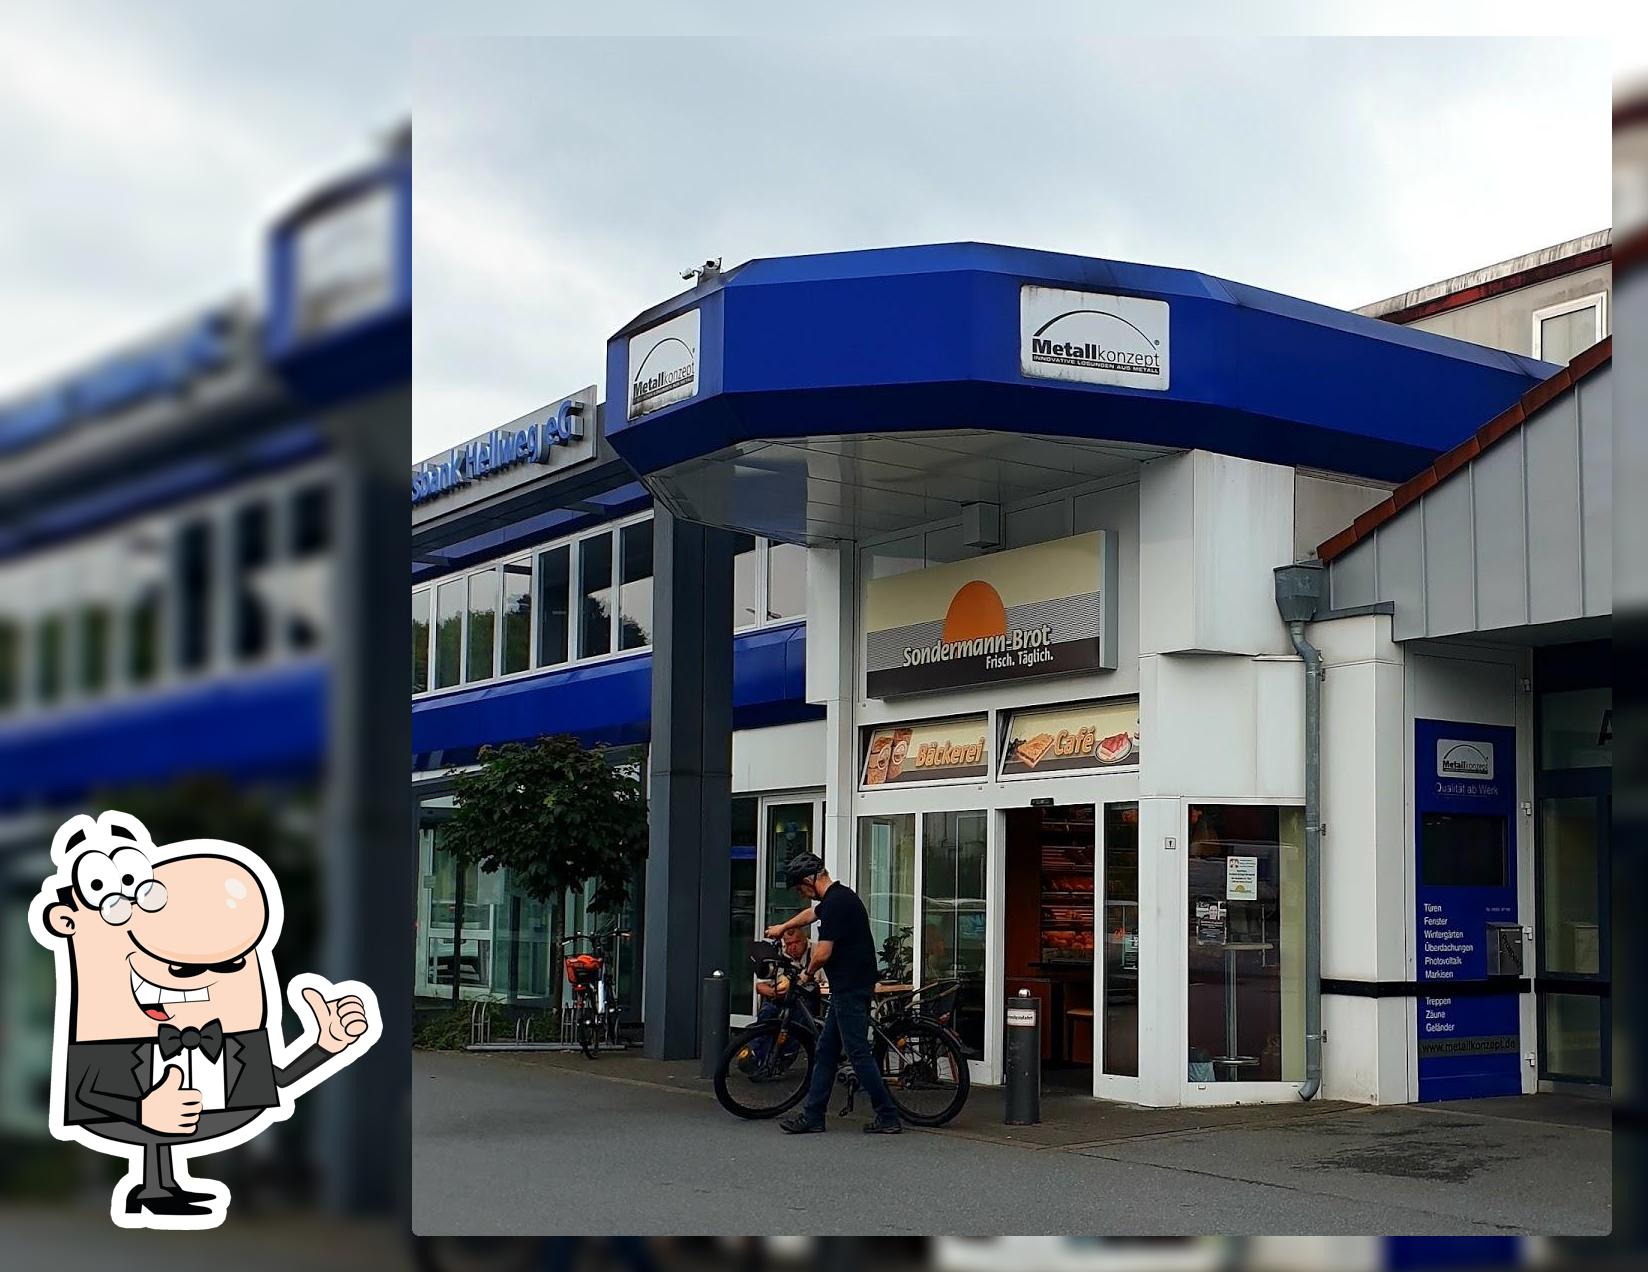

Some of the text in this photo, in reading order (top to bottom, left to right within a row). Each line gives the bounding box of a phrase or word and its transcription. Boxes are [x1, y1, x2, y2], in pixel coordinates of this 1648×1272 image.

[1032, 339, 1159, 367] Metallkonzept
[1033, 354, 1077, 365] INNOVATIVE
[1116, 364, 1131, 372] AUS
[1132, 366, 1159, 374] METALL
[633, 362, 695, 399] Metallkonzept
[465, 424, 546, 480] Hellweg
[545, 399, 584, 446] eG
[902, 624, 1051, 666] Sondermann-Brot
[985, 647, 1054, 670] Frisch. Täglich.
[1053, 725, 1096, 757] Café
[915, 737, 984, 767] Bäckerei
[1435, 782, 1499, 795] Qualität ab Werk
[1424, 903, 1442, 913] Türen
[1424, 916, 1448, 926] Fenster
[1424, 929, 1464, 940] Wintergärten
[1424, 941, 1474, 953] Überdachungen
[1425, 956, 1463, 965] Photovoltaik
[1425, 970, 1454, 979] Markisen
[1425, 996, 1452, 1007] Treppen
[1425, 1010, 1446, 1019] Zäune
[1425, 1023, 1455, 1032] Geländer
